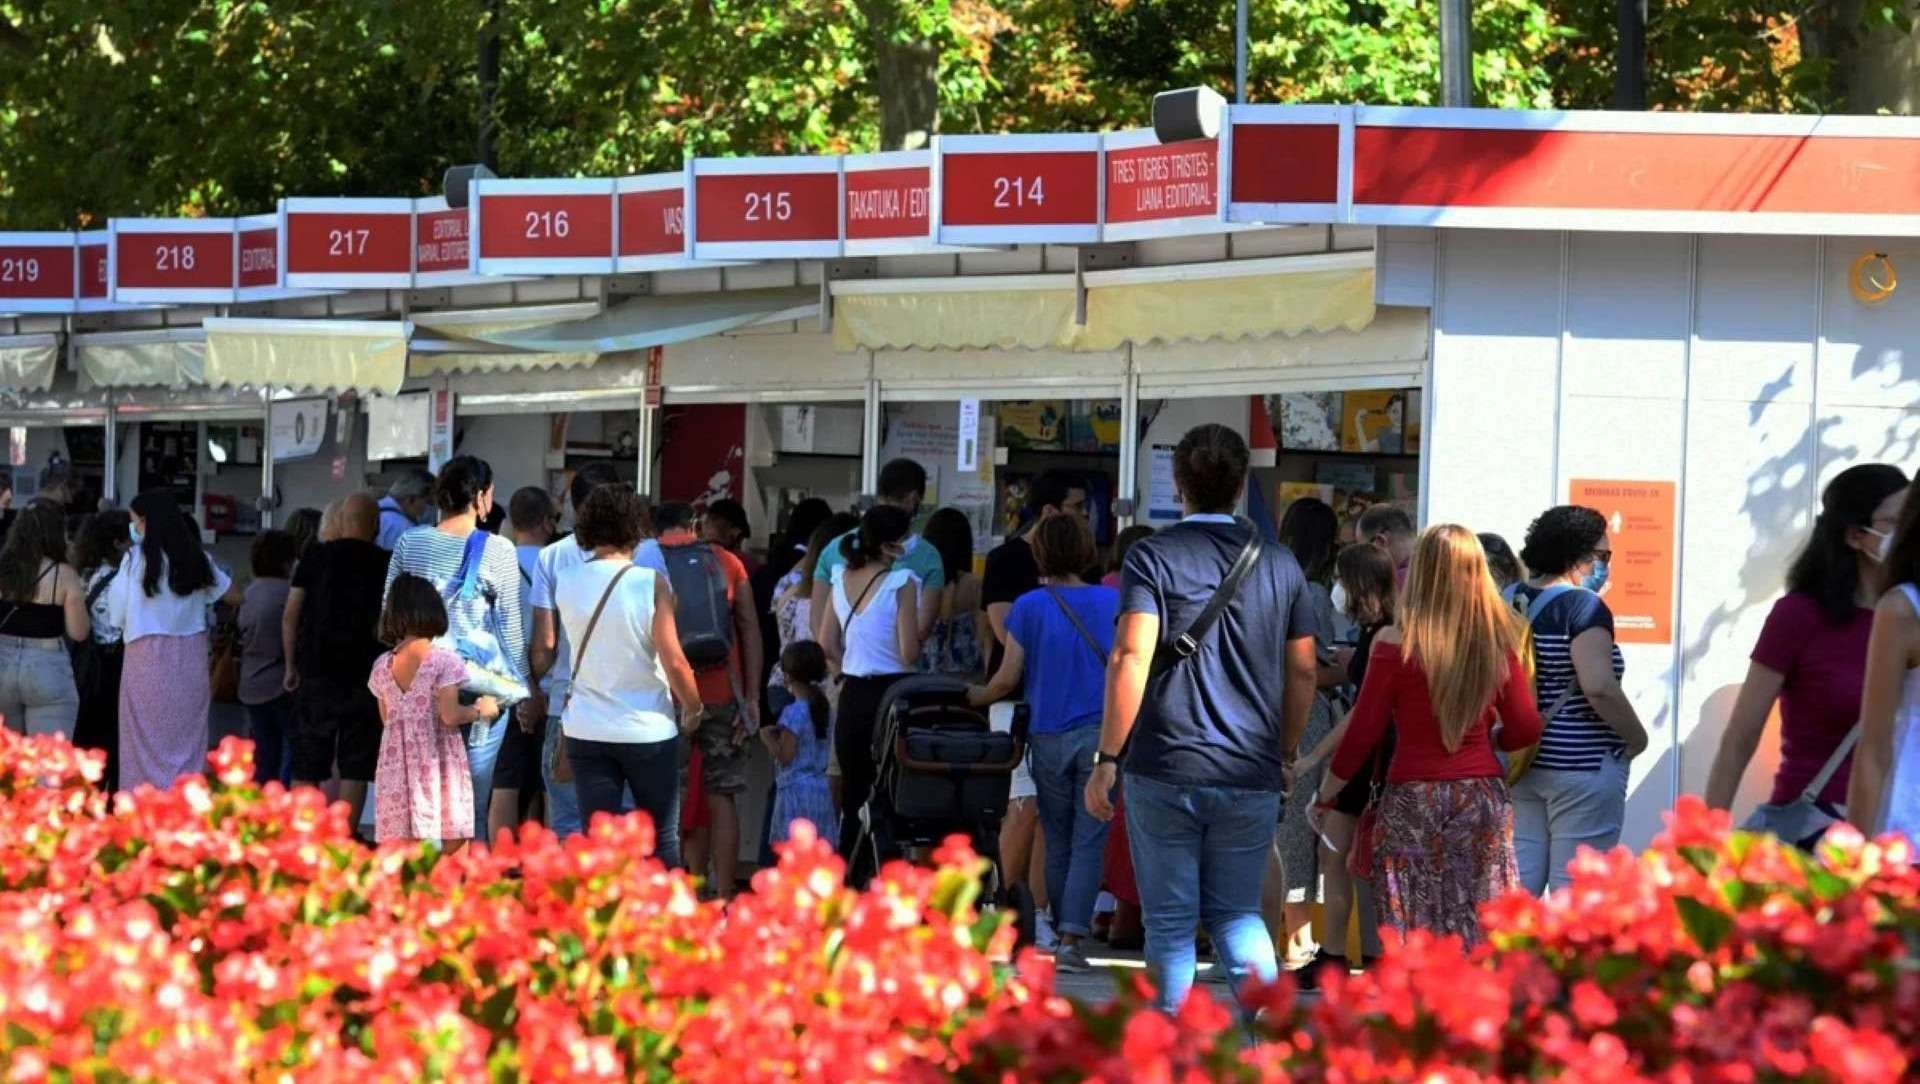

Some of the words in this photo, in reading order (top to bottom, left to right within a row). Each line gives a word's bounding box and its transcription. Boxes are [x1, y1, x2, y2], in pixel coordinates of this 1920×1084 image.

[1112, 158, 1136, 184] TRES
[1137, 155, 1168, 182] TIGRES
[1170, 151, 1208, 178] TRISTES
[744, 192, 792, 221] 215
[848, 189, 899, 219] TAKATUKA
[993, 176, 1045, 208] 214
[1136, 185, 1163, 212] LIANA
[1165, 181, 1211, 209] EDITORIAL
[525, 211, 570, 238] 216
[663, 206, 684, 235] VAS
[329, 229, 370, 256] 217
[1, 258, 39, 282] 219
[156, 245, 195, 270] 218
[242, 247, 276, 272] EDITORIAL
